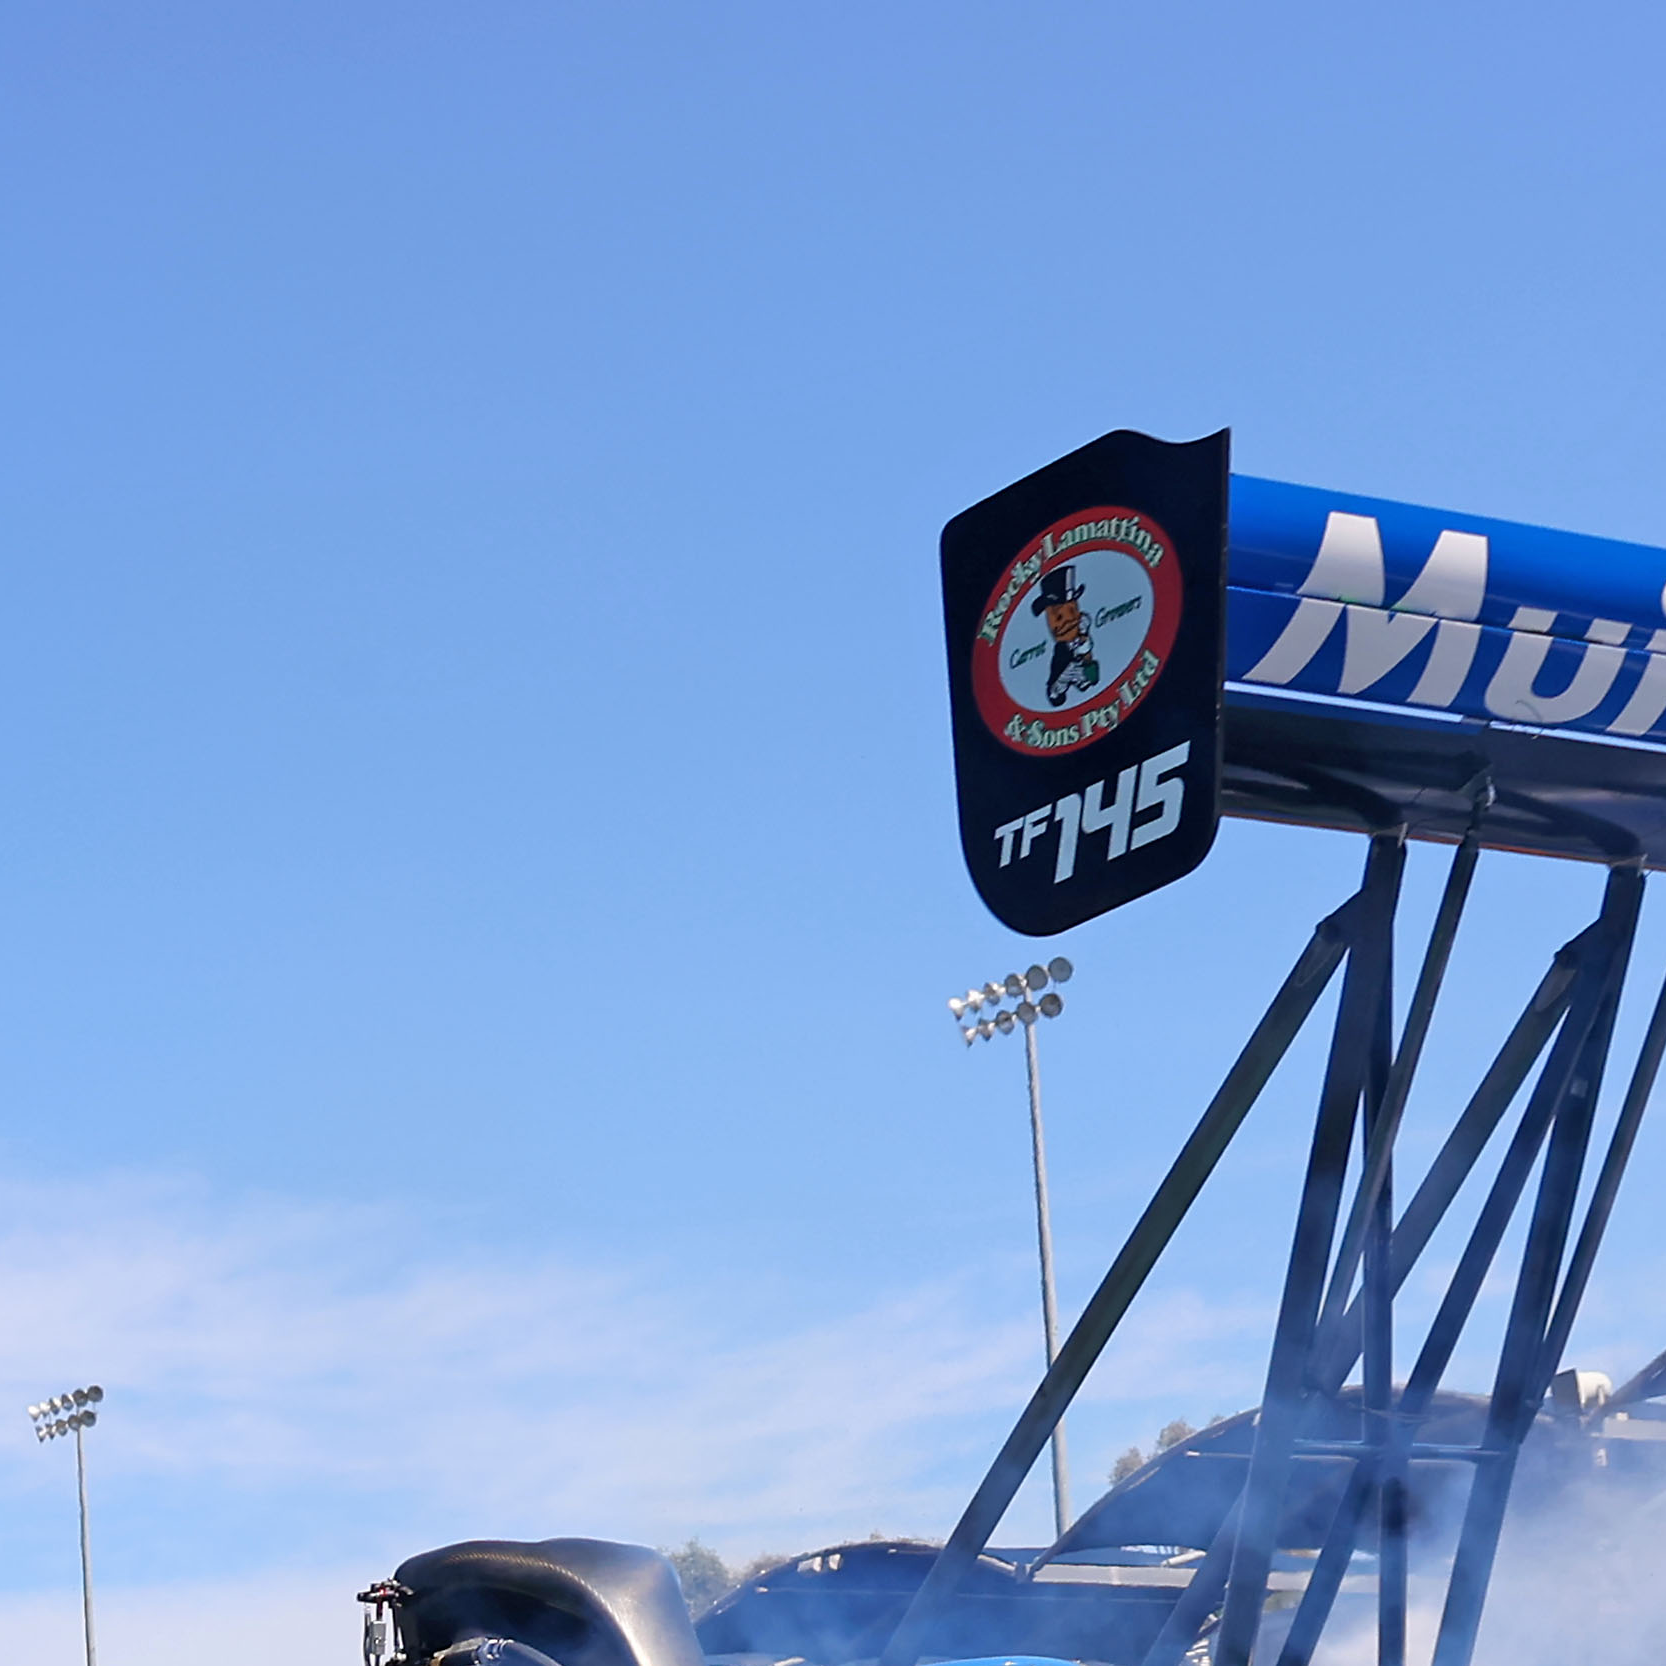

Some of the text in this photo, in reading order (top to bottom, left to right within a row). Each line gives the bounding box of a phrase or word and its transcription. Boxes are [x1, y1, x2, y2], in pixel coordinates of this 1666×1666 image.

[976, 516, 1165, 646] Rocky Lamattina
[1026, 719, 1080, 748] Sons
[1081, 699, 1121, 740] Pty
[1117, 649, 1160, 709] Ltd
